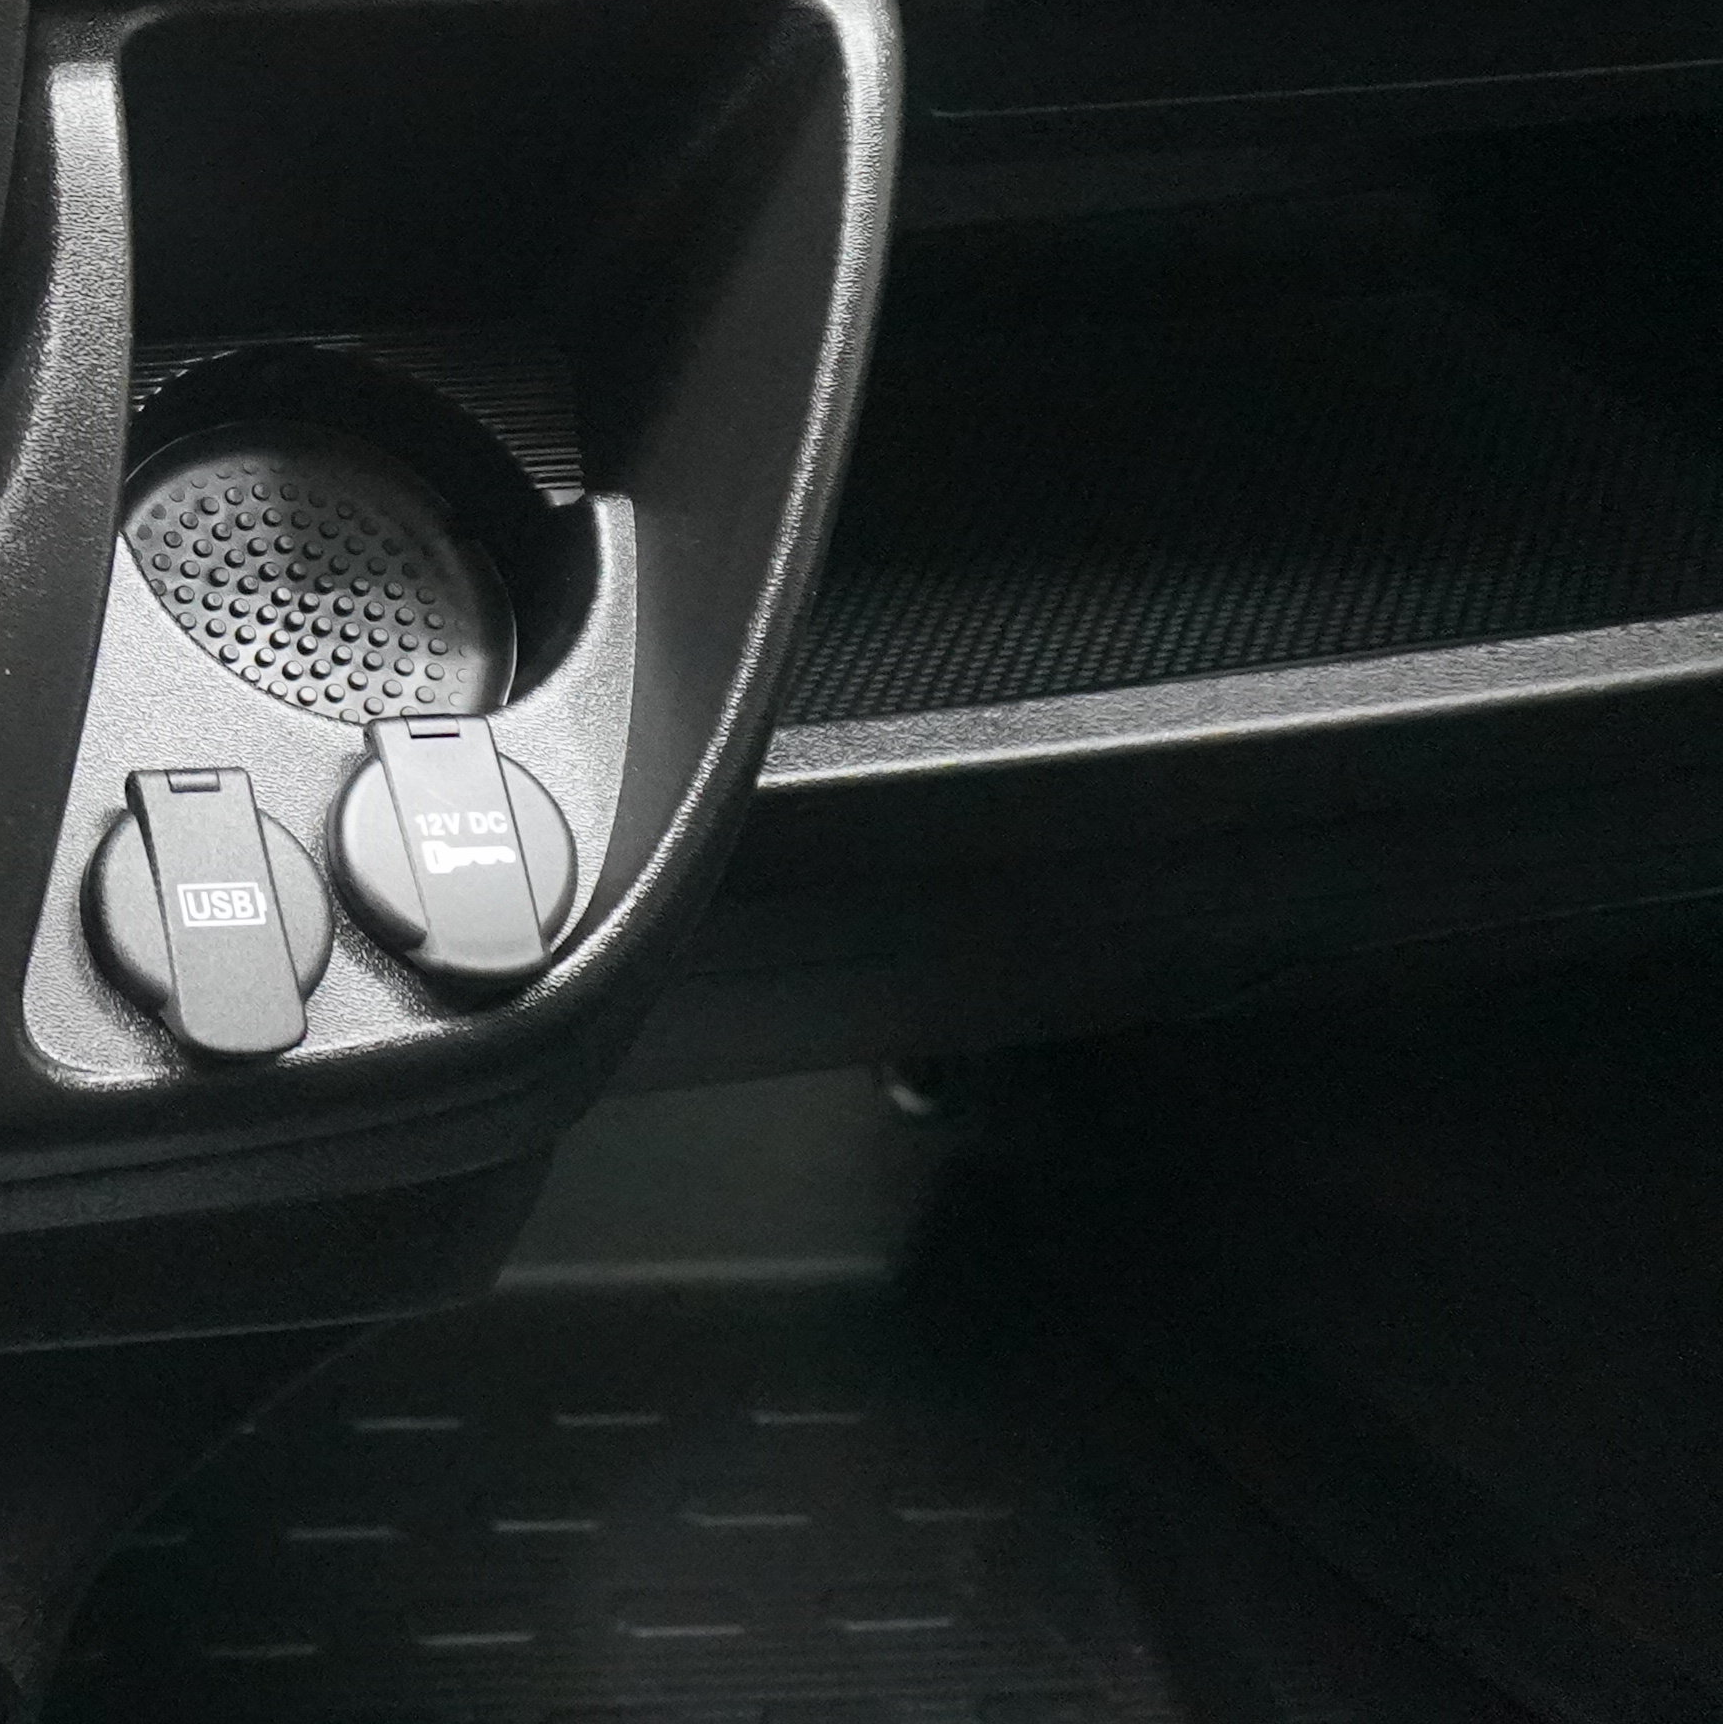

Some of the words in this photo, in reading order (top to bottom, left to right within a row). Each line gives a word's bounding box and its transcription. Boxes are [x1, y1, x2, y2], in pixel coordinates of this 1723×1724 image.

[415, 812, 460, 837] 12V
[467, 810, 508, 834] DC
[186, 890, 254, 921] USB
